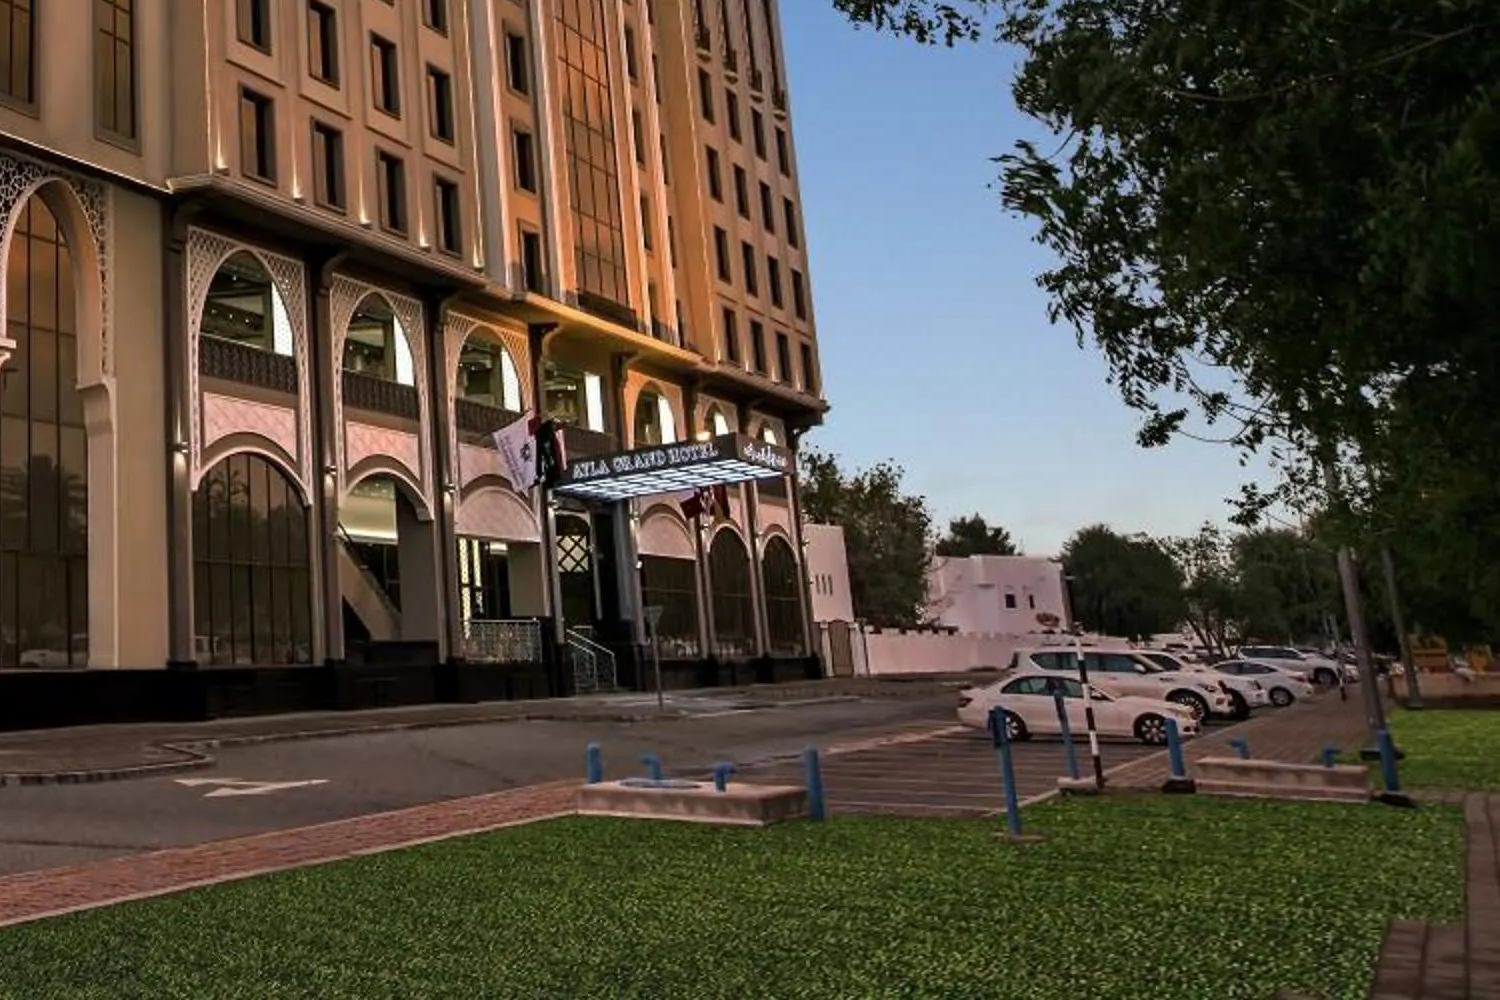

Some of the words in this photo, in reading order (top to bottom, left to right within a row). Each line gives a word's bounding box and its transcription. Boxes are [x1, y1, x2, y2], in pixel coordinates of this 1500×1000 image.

[572, 459, 611, 479] AYLA
[612, 449, 667, 473] GRAND
[668, 441, 719, 464] HOTEL
